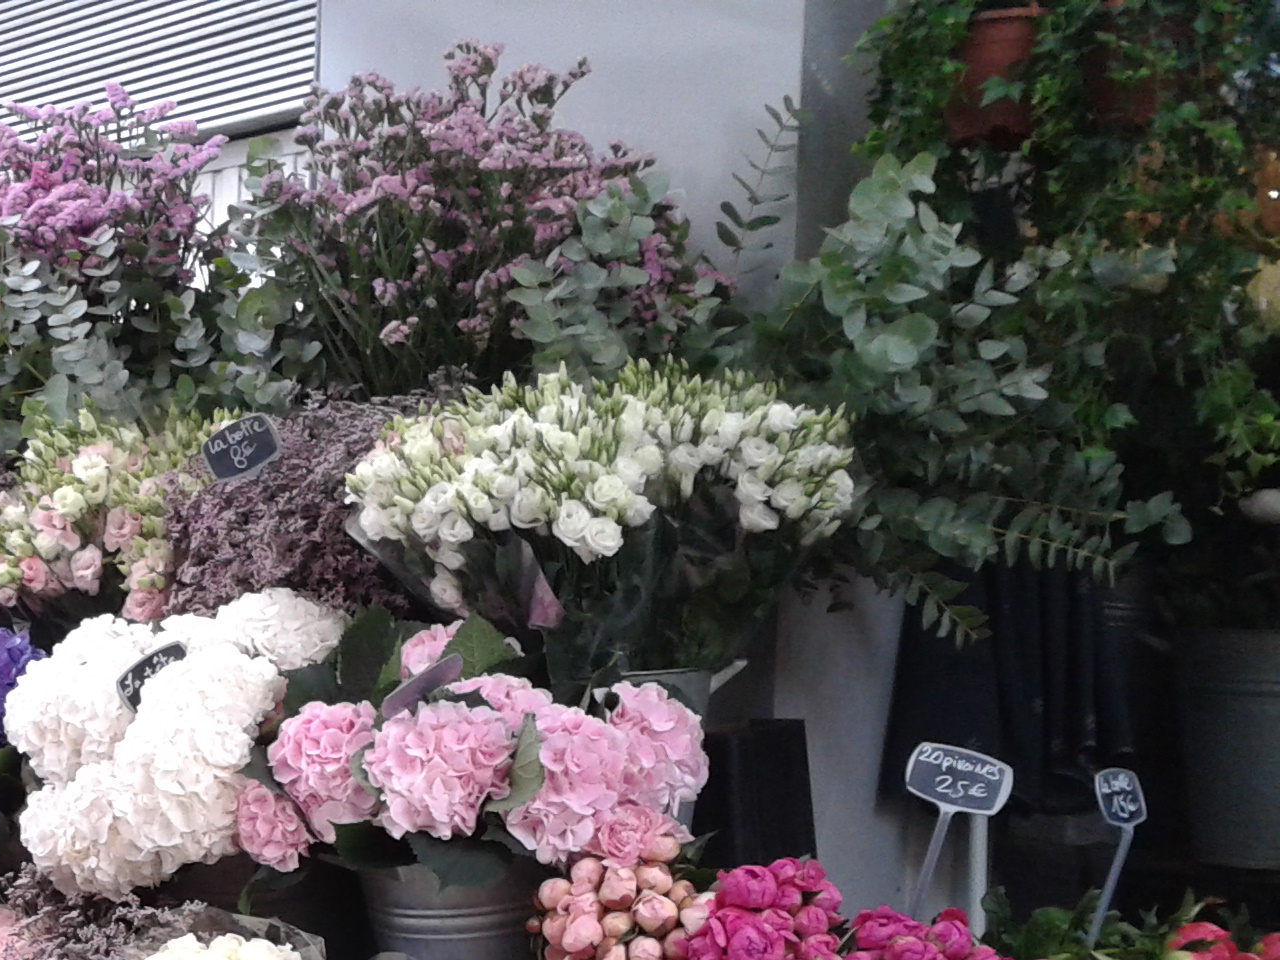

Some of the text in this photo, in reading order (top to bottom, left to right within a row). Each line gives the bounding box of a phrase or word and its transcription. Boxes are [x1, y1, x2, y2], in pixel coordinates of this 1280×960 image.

[226, 419, 267, 446] botte
[229, 441, 257, 469] 8€
[934, 775, 989, 799] 25€
